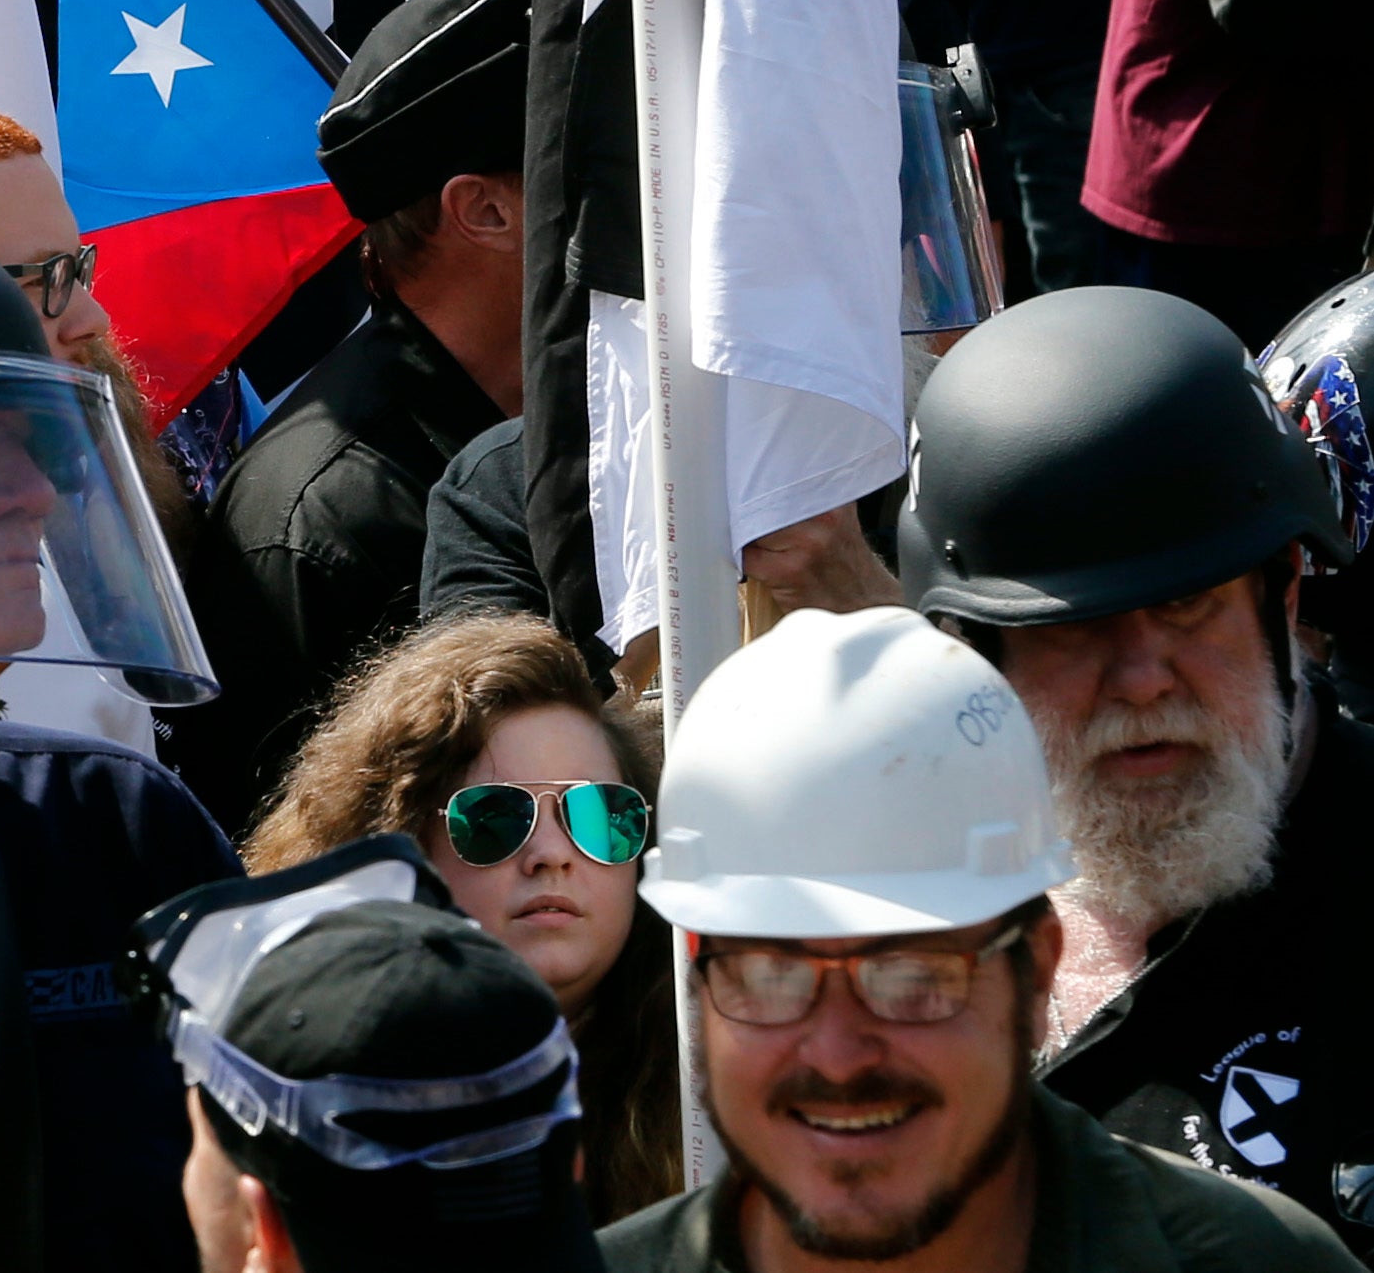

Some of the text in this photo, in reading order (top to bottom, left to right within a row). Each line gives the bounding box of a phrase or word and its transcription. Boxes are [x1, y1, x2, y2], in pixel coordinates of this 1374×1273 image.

[644, 19, 658, 82] 05/17/17
[647, 92, 660, 137] U.S.A.
[650, 144, 661, 159] IN
[650, 167, 662, 200] MADE
[656, 312, 669, 342] 1785
[658, 351, 670, 360] D
[659, 366, 672, 399] ASTM
[668, 606, 681, 629] PSI
[669, 635, 682, 660] 330
[1199, 1026, 1301, 1083] League of
[1181, 1114, 1202, 1143] For
